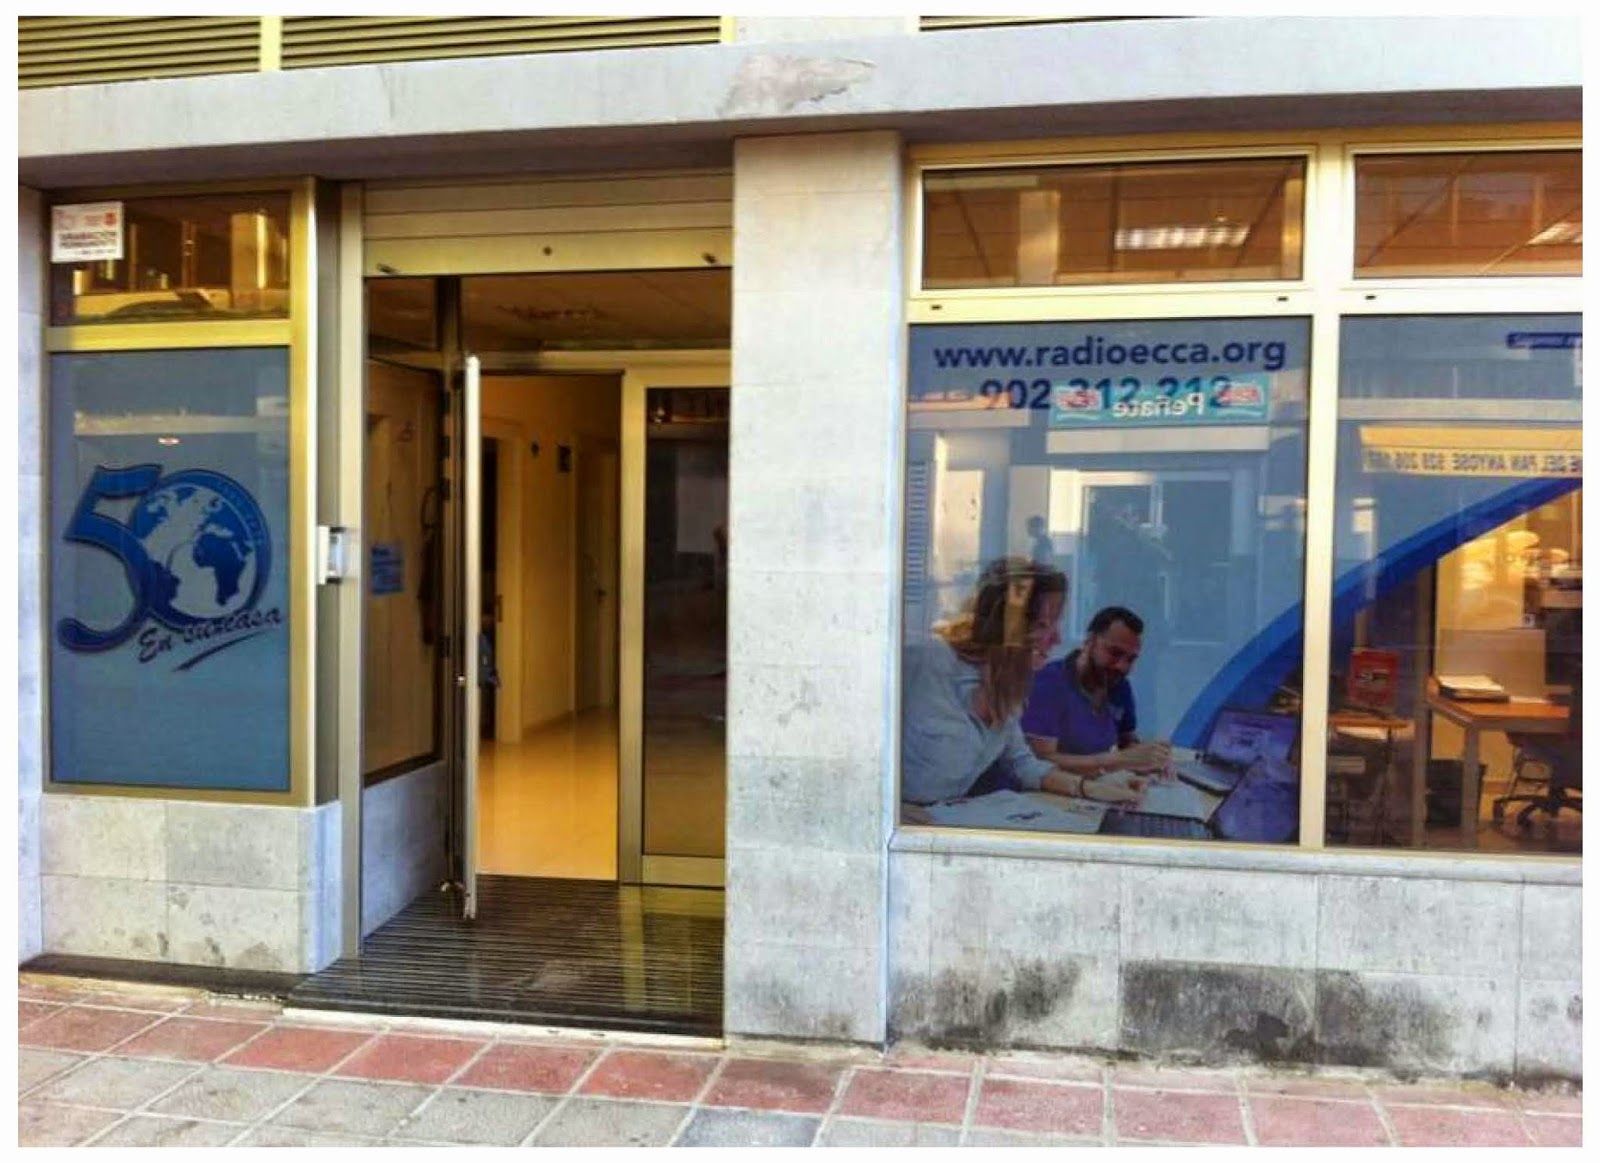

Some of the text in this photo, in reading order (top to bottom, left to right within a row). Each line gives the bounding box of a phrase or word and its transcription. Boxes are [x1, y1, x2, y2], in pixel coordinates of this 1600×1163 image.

[934, 336, 1286, 371] www.radioecca.org
[981, 378, 1051, 410] 902
[1068, 377, 1141, 409] 312
[57, 463, 272, 654] 50
[138, 627, 172, 663] En
[223, 606, 281, 633] casa
